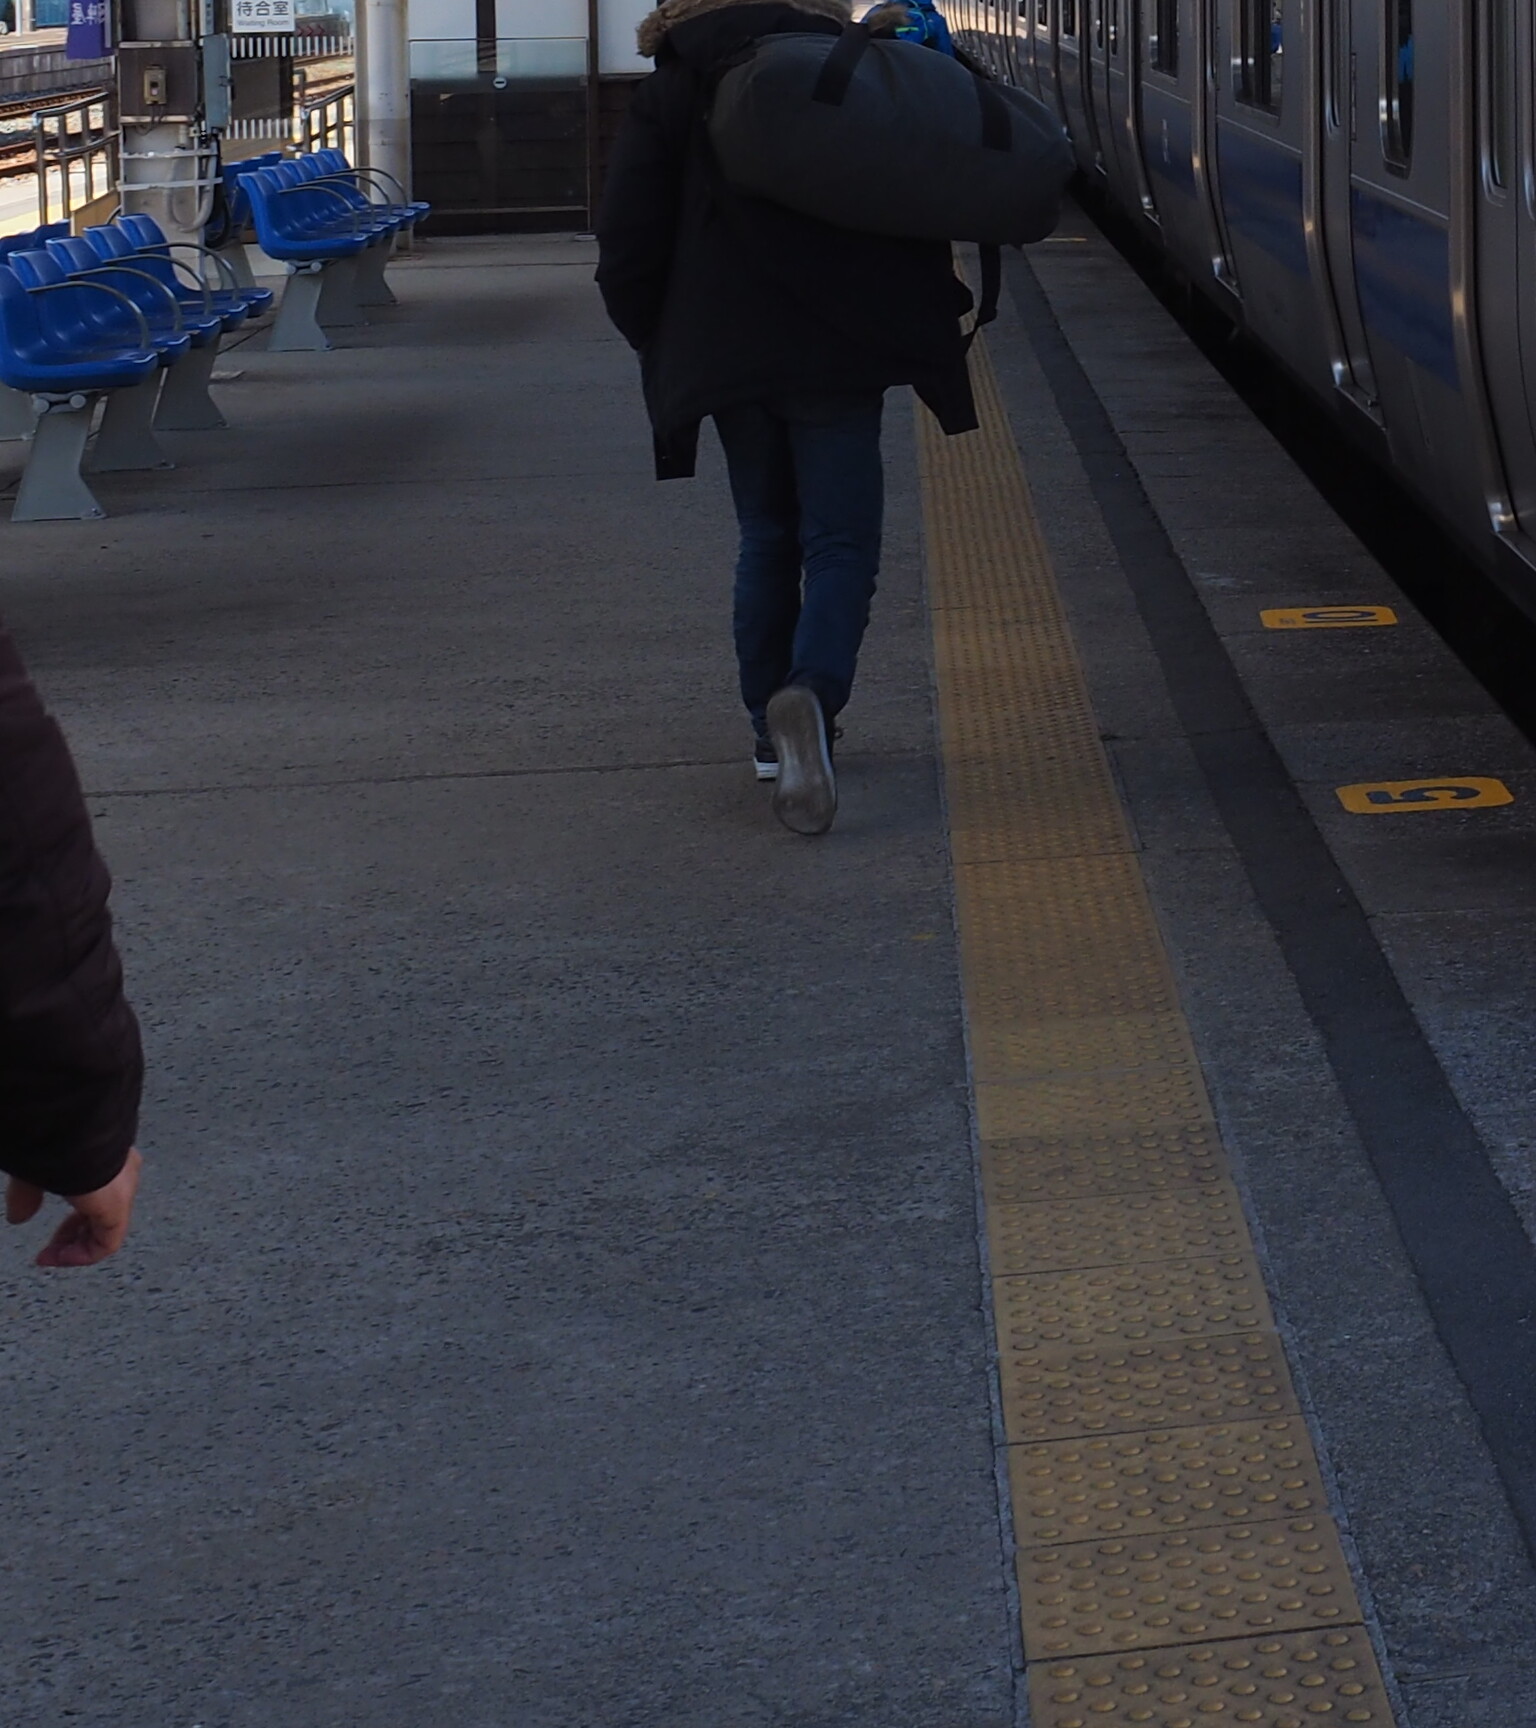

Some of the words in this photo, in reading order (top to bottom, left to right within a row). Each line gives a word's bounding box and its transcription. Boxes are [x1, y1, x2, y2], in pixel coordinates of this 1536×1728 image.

[236, 0, 289, 17] 待合室
[1366, 785, 1481, 805] 5
